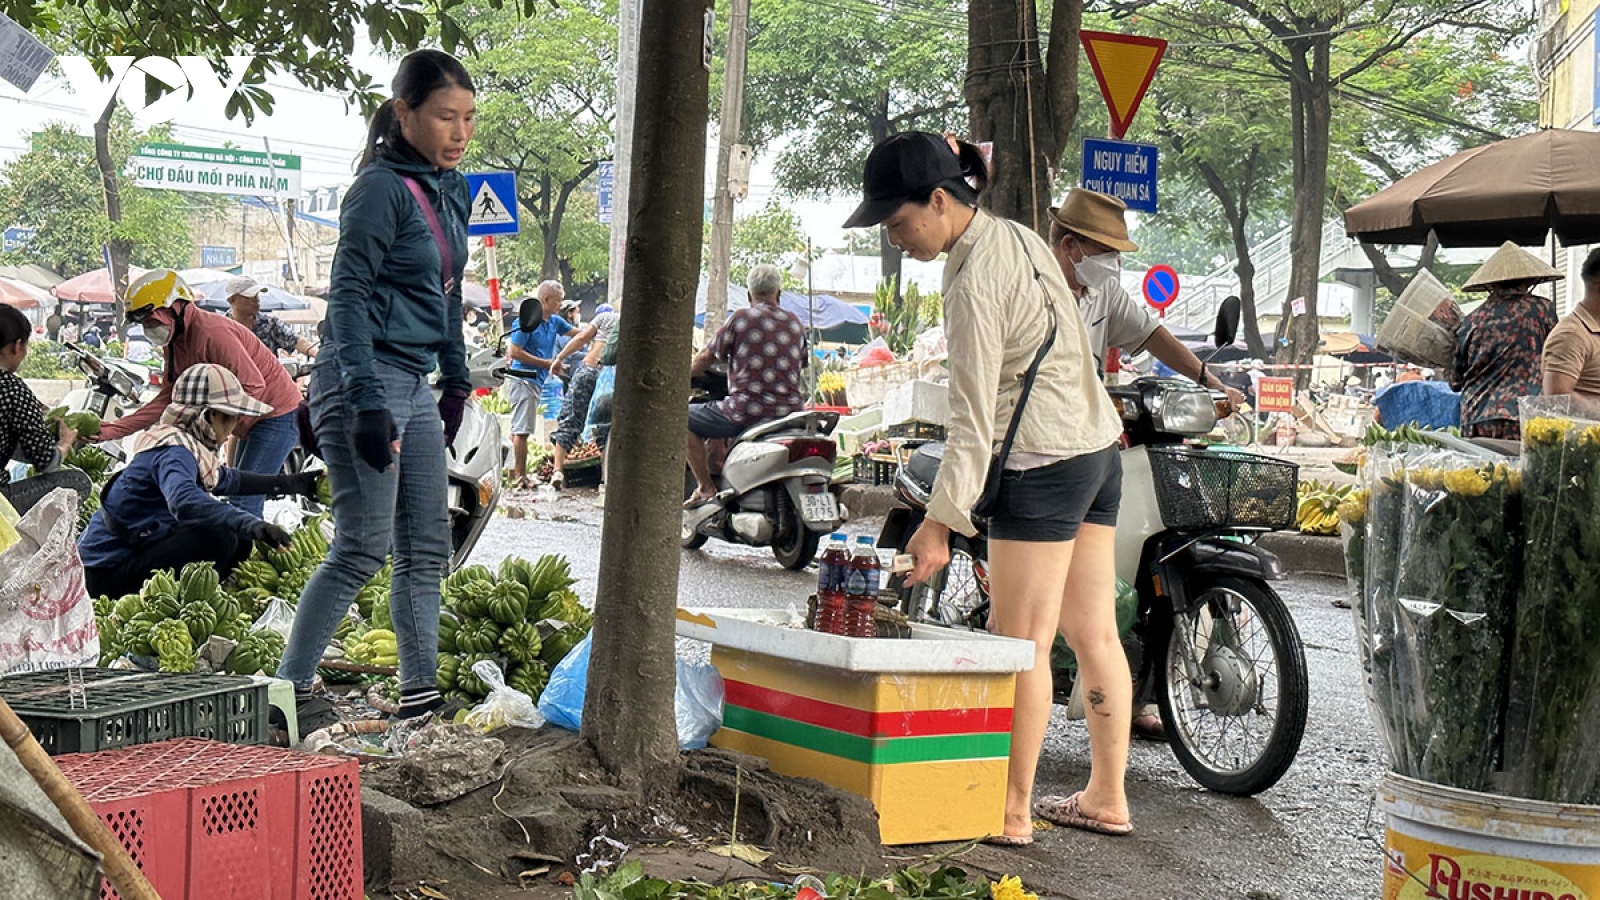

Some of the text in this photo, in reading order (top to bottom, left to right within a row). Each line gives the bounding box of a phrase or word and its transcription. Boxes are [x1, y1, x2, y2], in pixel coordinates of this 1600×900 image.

[1093, 146, 1148, 175] NGUY HIỂM
[138, 166, 164, 185] CHỢ
[198, 167, 222, 186] MỐI
[226, 171, 256, 189] PHÍA
[259, 175, 288, 191] NAM
[1114, 181, 1138, 200] QUAN
[1426, 853, 1577, 900] PUSH
